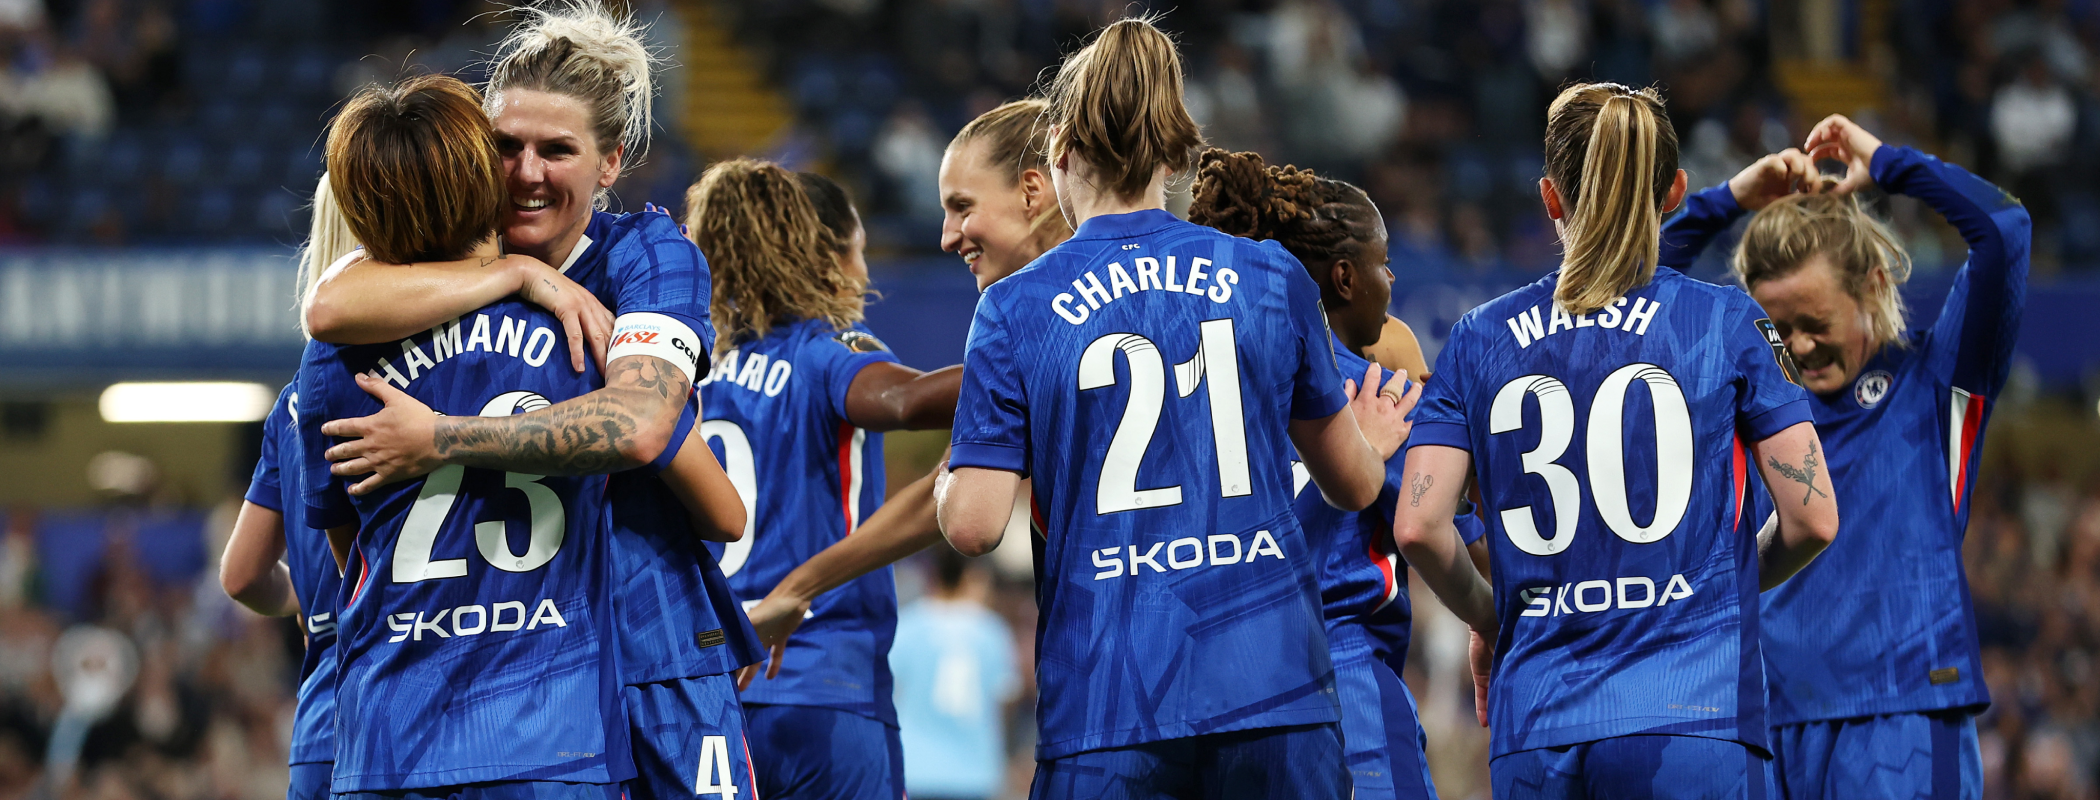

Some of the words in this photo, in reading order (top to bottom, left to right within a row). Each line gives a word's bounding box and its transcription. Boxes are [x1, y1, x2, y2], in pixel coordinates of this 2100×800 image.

[1051, 255, 1239, 325] CHARLES
[367, 313, 556, 389] HAMANO
[609, 331, 661, 352] WSL
[624, 323, 661, 332] BARCLAYS
[1078, 318, 1253, 515] 21
[391, 390, 566, 583] 23
[1489, 362, 1694, 556] 30
[1092, 530, 1286, 581] SKODA
[386, 598, 567, 644] SKODA
[1520, 573, 1695, 617] SKODA
[695, 735, 738, 800] 4
